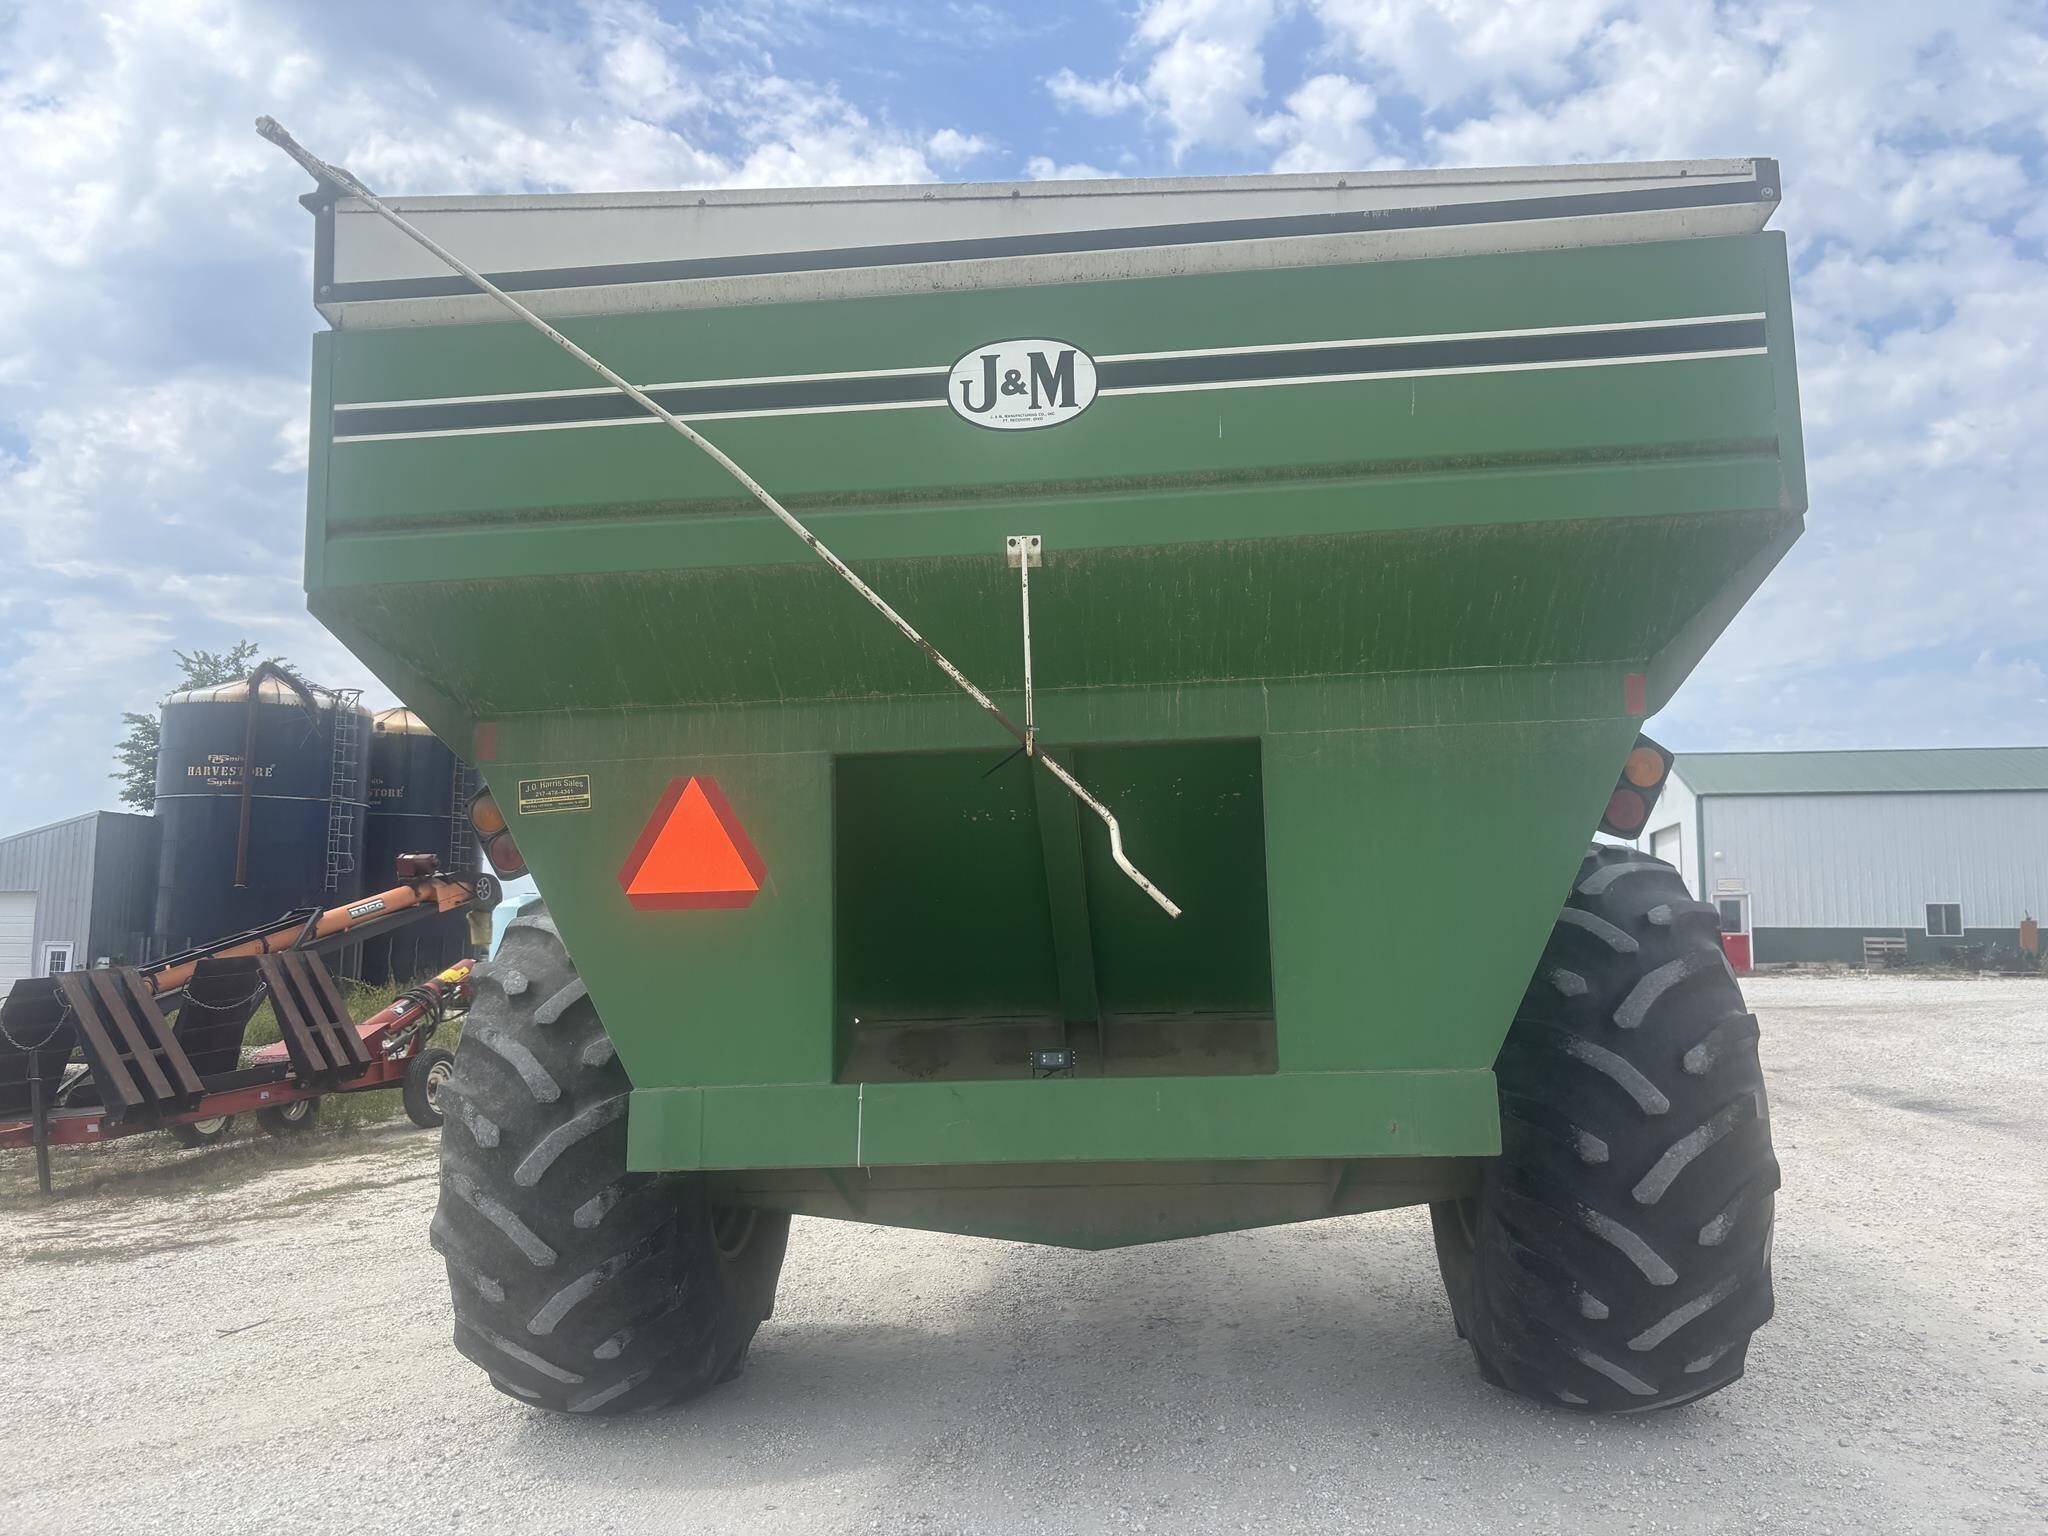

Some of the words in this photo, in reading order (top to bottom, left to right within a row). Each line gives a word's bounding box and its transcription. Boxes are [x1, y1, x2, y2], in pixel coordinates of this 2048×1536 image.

[959, 350, 1079, 413] J&M
[540, 780, 562, 788] Harris
[563, 779, 584, 788] Sales
